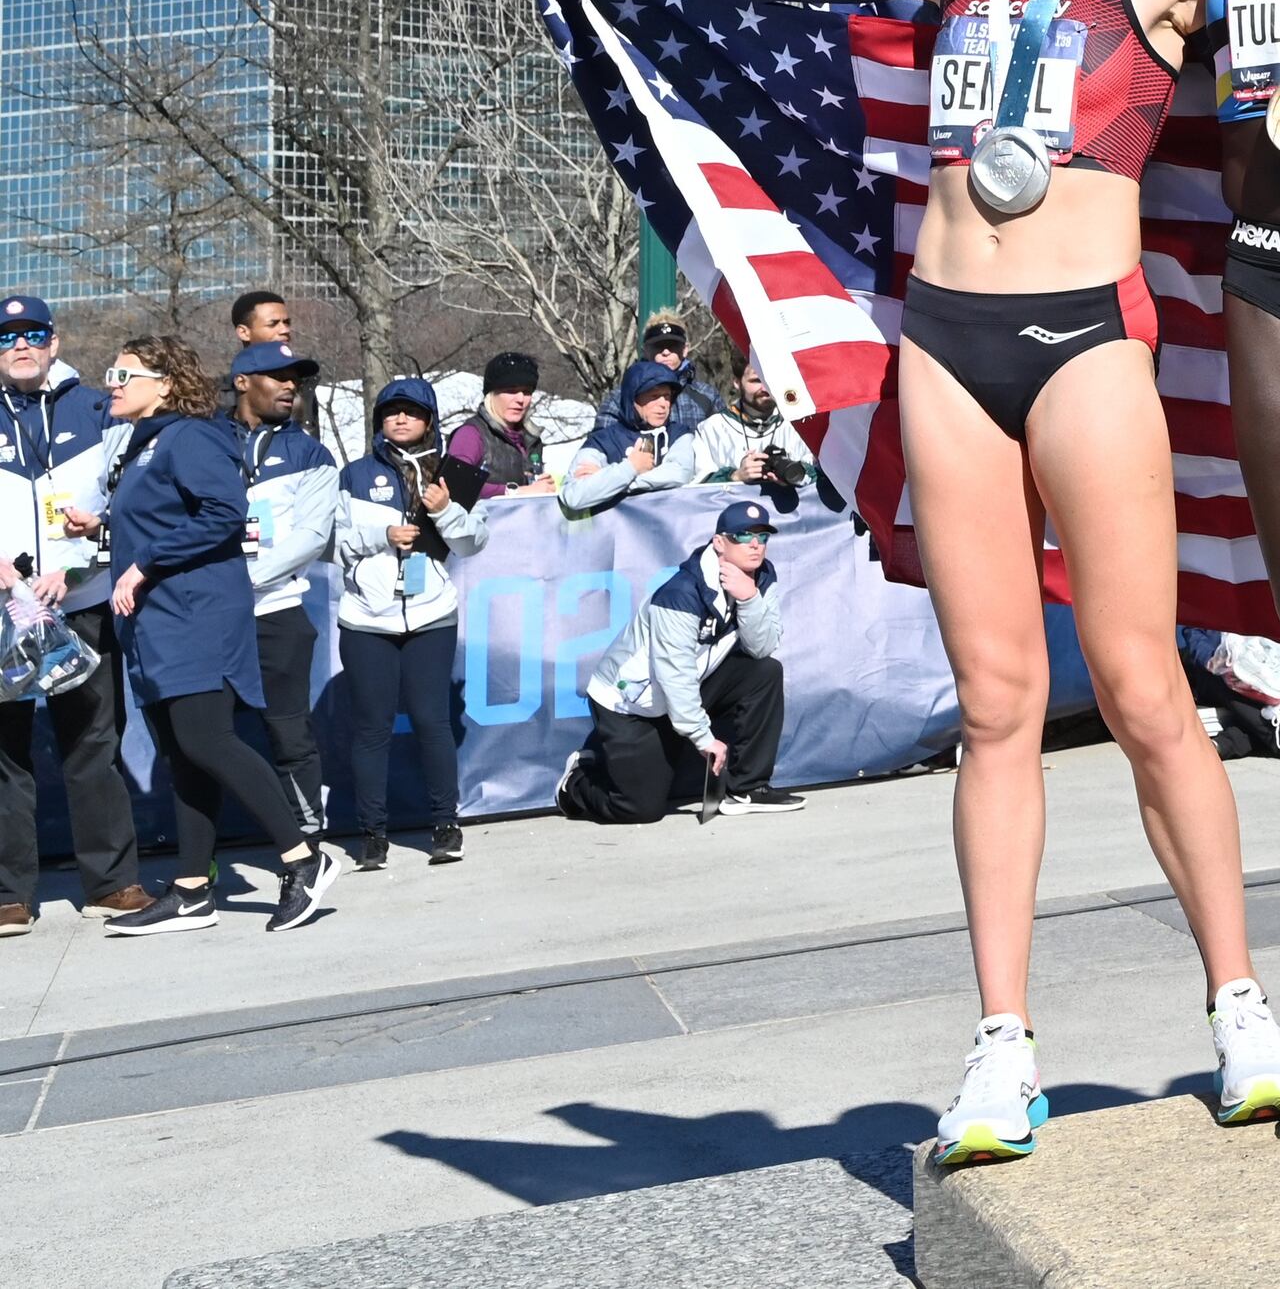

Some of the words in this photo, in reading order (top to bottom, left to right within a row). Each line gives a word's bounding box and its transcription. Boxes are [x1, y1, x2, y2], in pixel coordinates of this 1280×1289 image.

[962, 39, 989, 56] TEA
[941, 59, 1052, 114] SEIL
[45, 501, 54, 526] MEDIA
